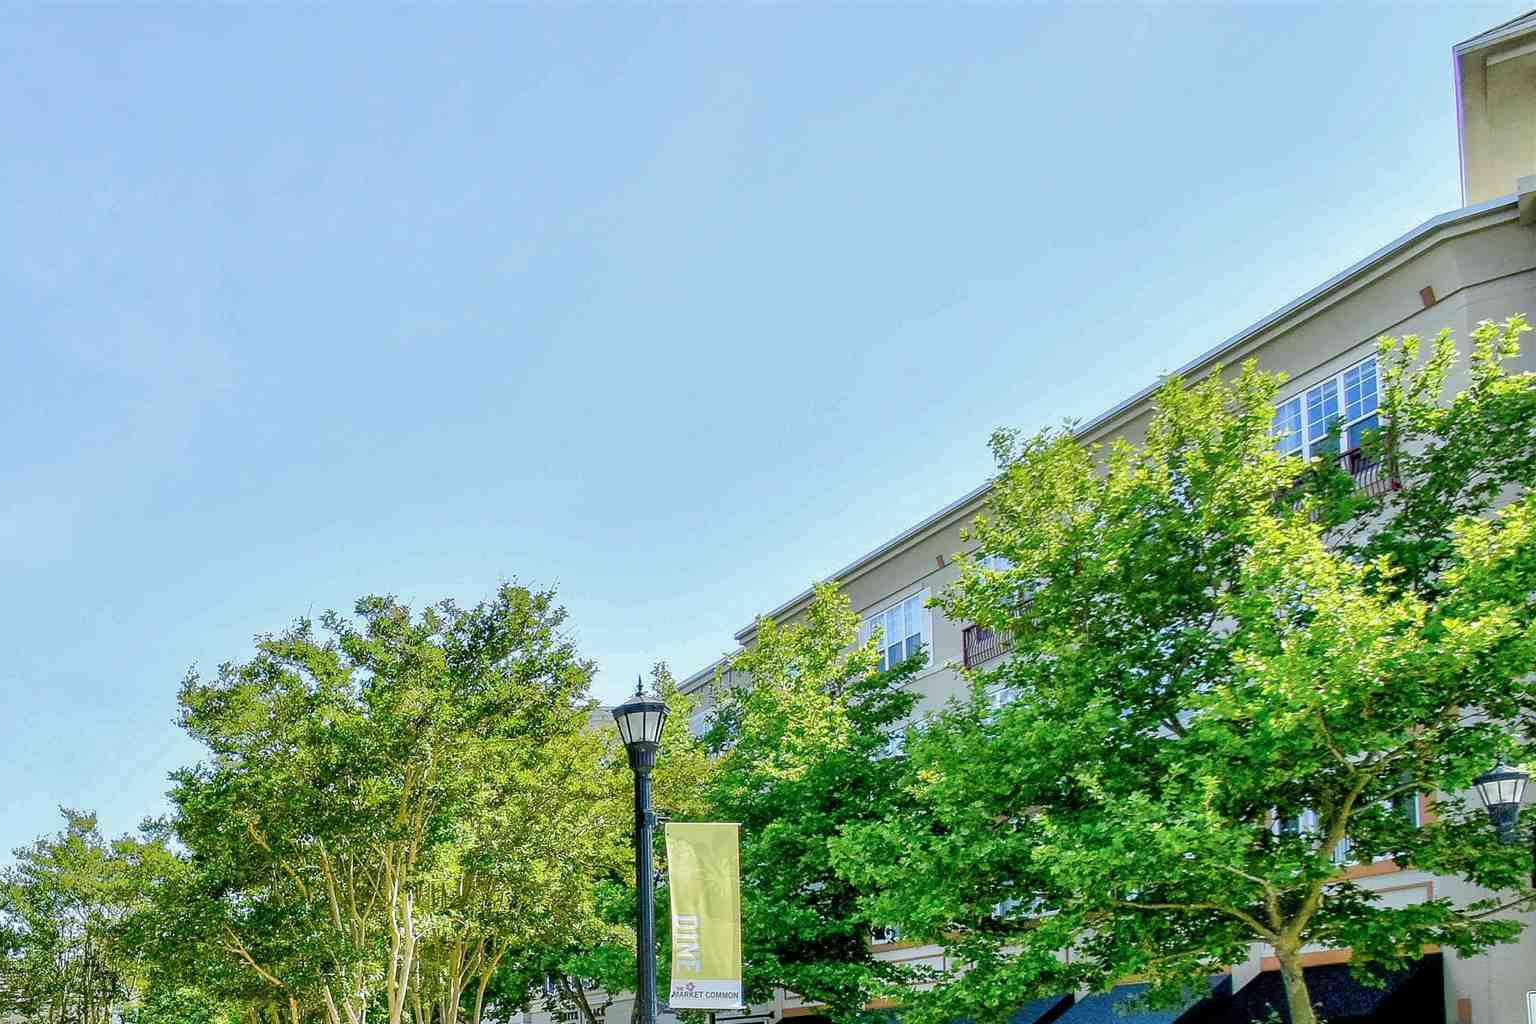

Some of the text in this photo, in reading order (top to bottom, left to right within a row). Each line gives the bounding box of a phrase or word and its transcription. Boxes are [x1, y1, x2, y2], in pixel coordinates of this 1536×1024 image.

[674, 913, 701, 974] DINE
[671, 991, 738, 999] MARKET COMMON
